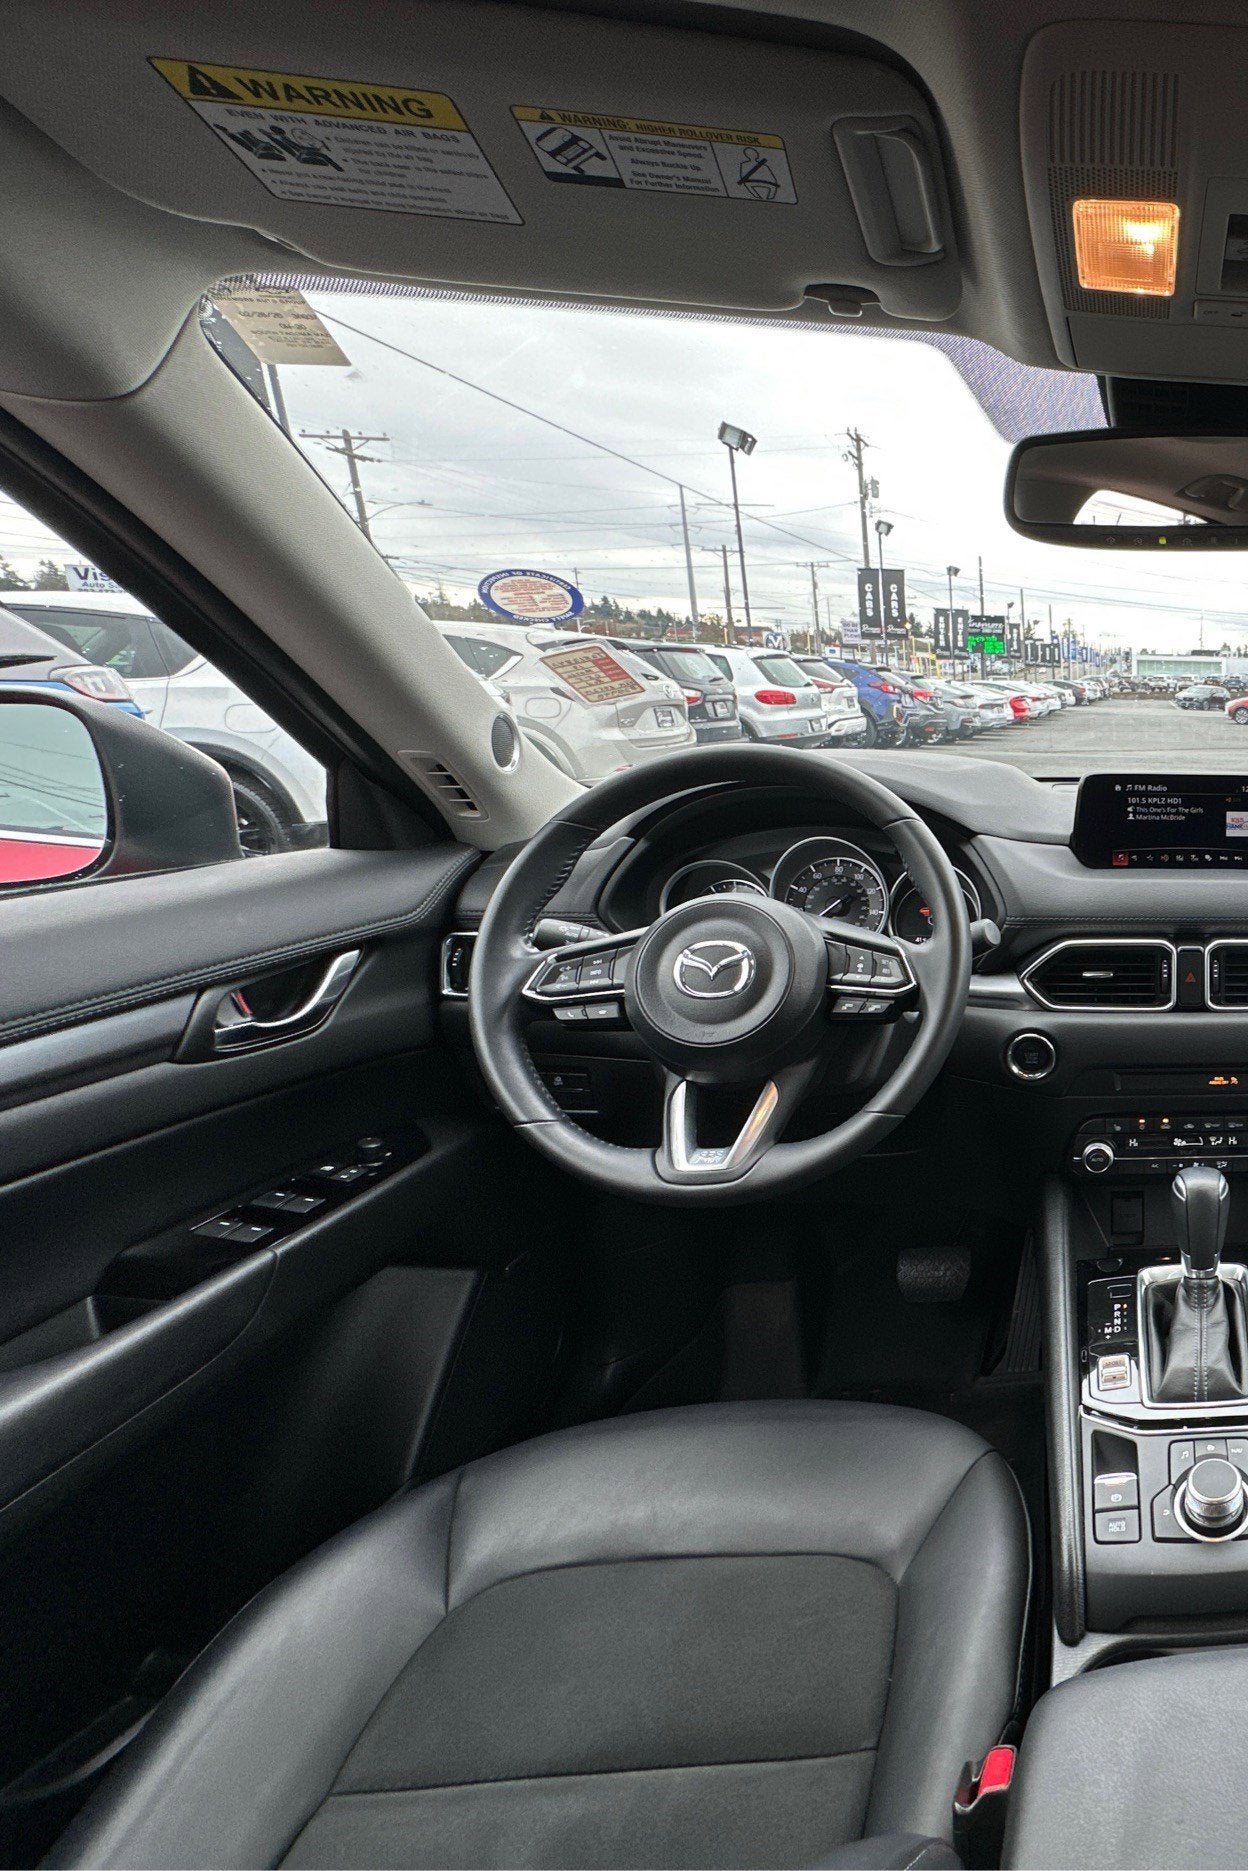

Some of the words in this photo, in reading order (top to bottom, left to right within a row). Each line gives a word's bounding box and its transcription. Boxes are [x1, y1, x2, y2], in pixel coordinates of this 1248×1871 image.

[232, 76, 436, 119] WARNING
[224, 108, 265, 120] EVEN
[268, 114, 308, 125] WITH
[311, 118, 388, 134] ADVANCED
[391, 128, 417, 138] AIR
[421, 132, 460, 143] BAGS
[557, 112, 631, 130] WARNING:
[634, 123, 676, 134] HIGHER
[677, 127, 733, 141] ROLLOVER
[735, 134, 761, 144] RISK
[864, 583, 874, 618] CARS
[889, 583, 899, 618] CARS
[1147, 784, 1168, 792] Radio
[813, 872, 822, 880] 60
[835, 866, 844, 874] 80
[1114, 1303, 1121, 1311] P
